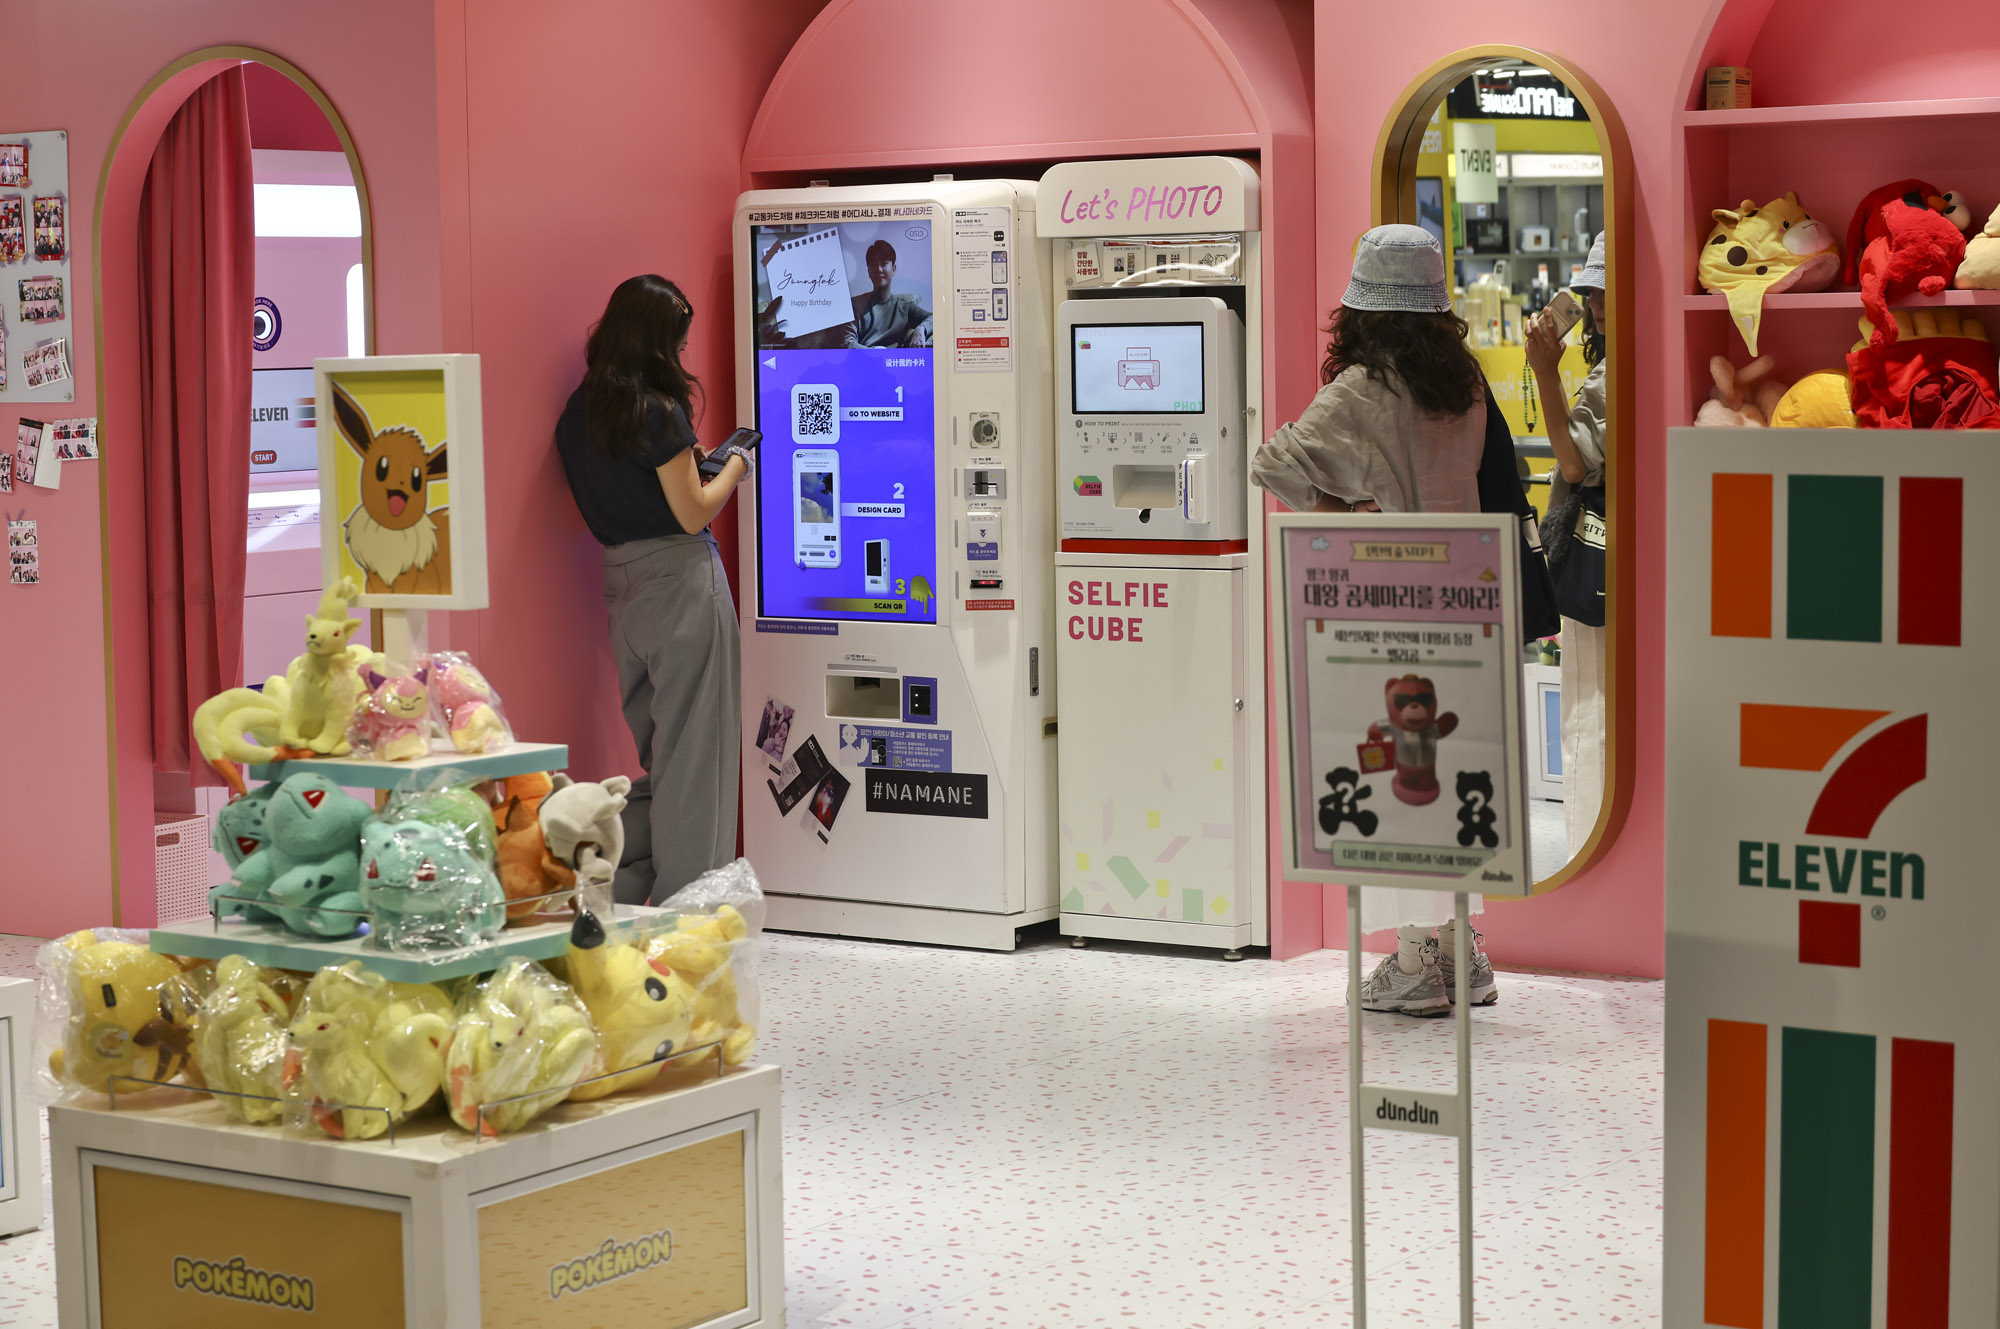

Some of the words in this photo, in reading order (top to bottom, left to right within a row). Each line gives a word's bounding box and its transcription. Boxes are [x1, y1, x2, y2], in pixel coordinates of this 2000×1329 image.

[1060, 188, 1118, 223] Let's
[1126, 185, 1222, 222] PHOTO
[749, 212, 792, 221] #교통카드처럼
[795, 210, 839, 220] #체크카드처럼
[894, 206, 932, 216] #나마네카드
[1076, 251, 1088, 259] 정말
[1076, 260, 1093, 268] 간단한
[1076, 268, 1099, 276] 사용방법
[777, 269, 840, 294] Youngtak
[809, 299, 832, 307] Birthday
[886, 358, 925, 367] 设计我的卡片
[895, 386, 904, 402] 1
[251, 406, 289, 422] LEVEn
[254, 453, 274, 462] START
[893, 483, 905, 499] 2
[895, 578, 906, 595] 3
[1068, 580, 1169, 608] SELFIE
[1304, 584, 1339, 608] 대왕
[1346, 584, 1434, 610] 곰세마리를
[1440, 586, 1500, 611] 찾아라!
[1068, 616, 1143, 642] CUBE
[873, 782, 972, 805] #NAMANE
[1376, 1098, 1439, 1126] dundun
[550, 1228, 672, 1300] POKÉMON
[174, 1256, 314, 1312] POKÉMON
